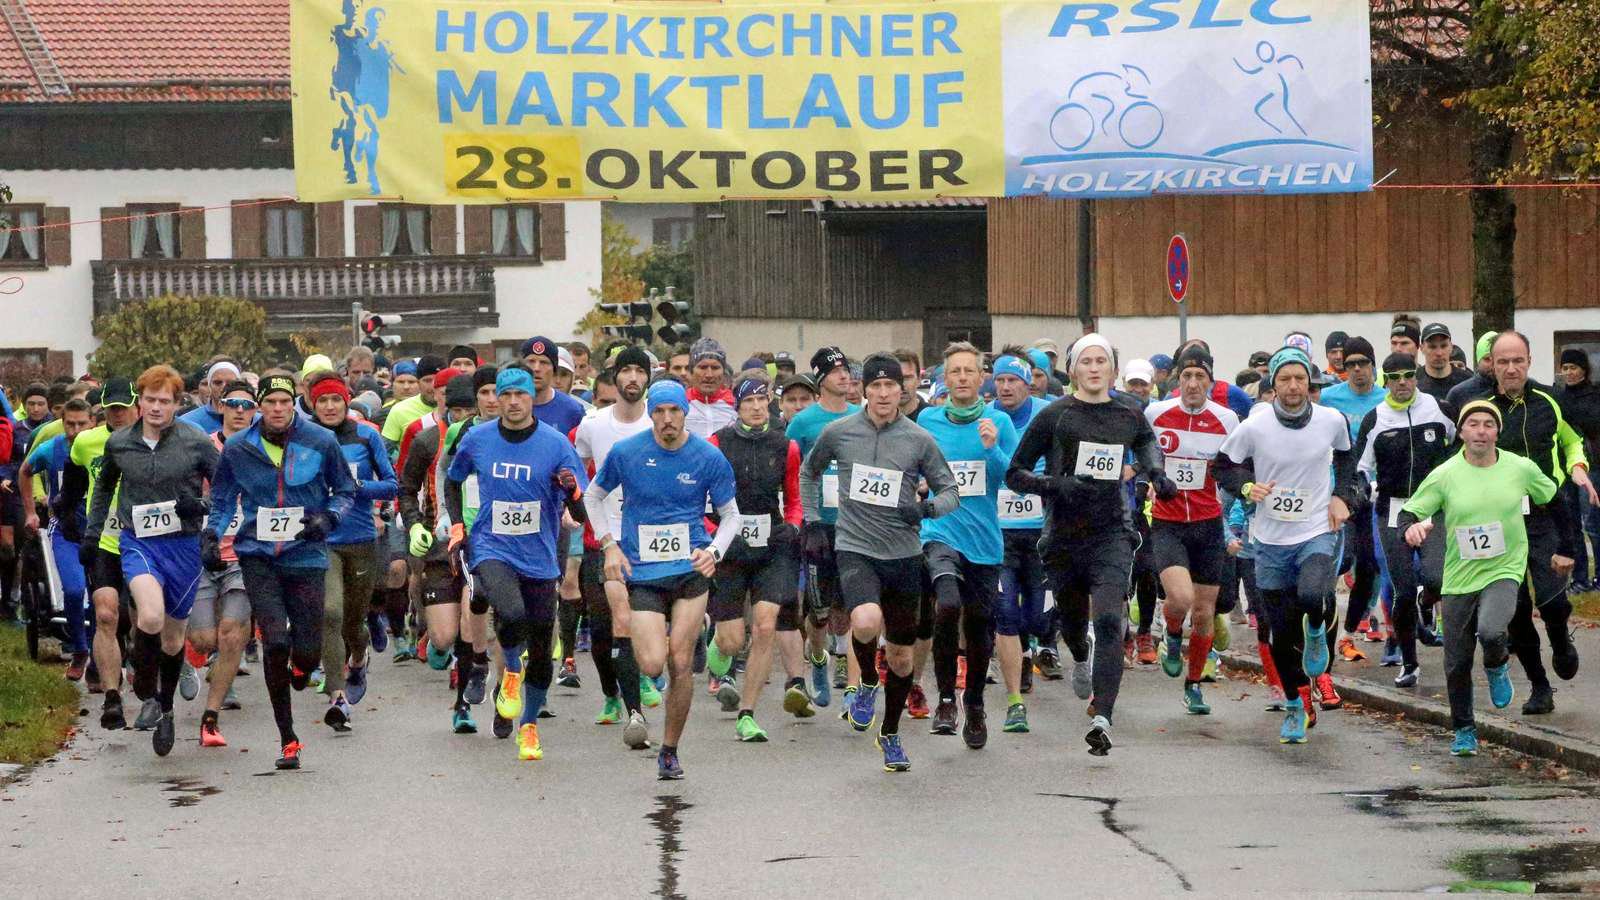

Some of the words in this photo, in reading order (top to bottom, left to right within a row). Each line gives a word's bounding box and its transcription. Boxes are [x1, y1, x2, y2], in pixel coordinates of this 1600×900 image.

[1048, 0, 1312, 38] RSLC
[436, 11, 964, 59] HOLZKIRCHNER
[437, 70, 965, 130] MARKTLAUF
[455, 145, 573, 190] 28.
[584, 147, 970, 192] OKTOBER
[1022, 161, 1356, 193] HOLZKIRCHEN
[1085, 455, 1115, 472] 466
[957, 471, 977, 487] 37
[1176, 469, 1194, 483] 33
[859, 478, 890, 498] 248
[1005, 500, 1033, 514] 790
[1272, 496, 1304, 513] 292
[142, 513, 171, 529] 270
[270, 517, 291, 532] 27
[501, 511, 533, 527] 384
[741, 526, 760, 540] 64
[648, 537, 681, 553] 426
[1469, 534, 1492, 550] 12
